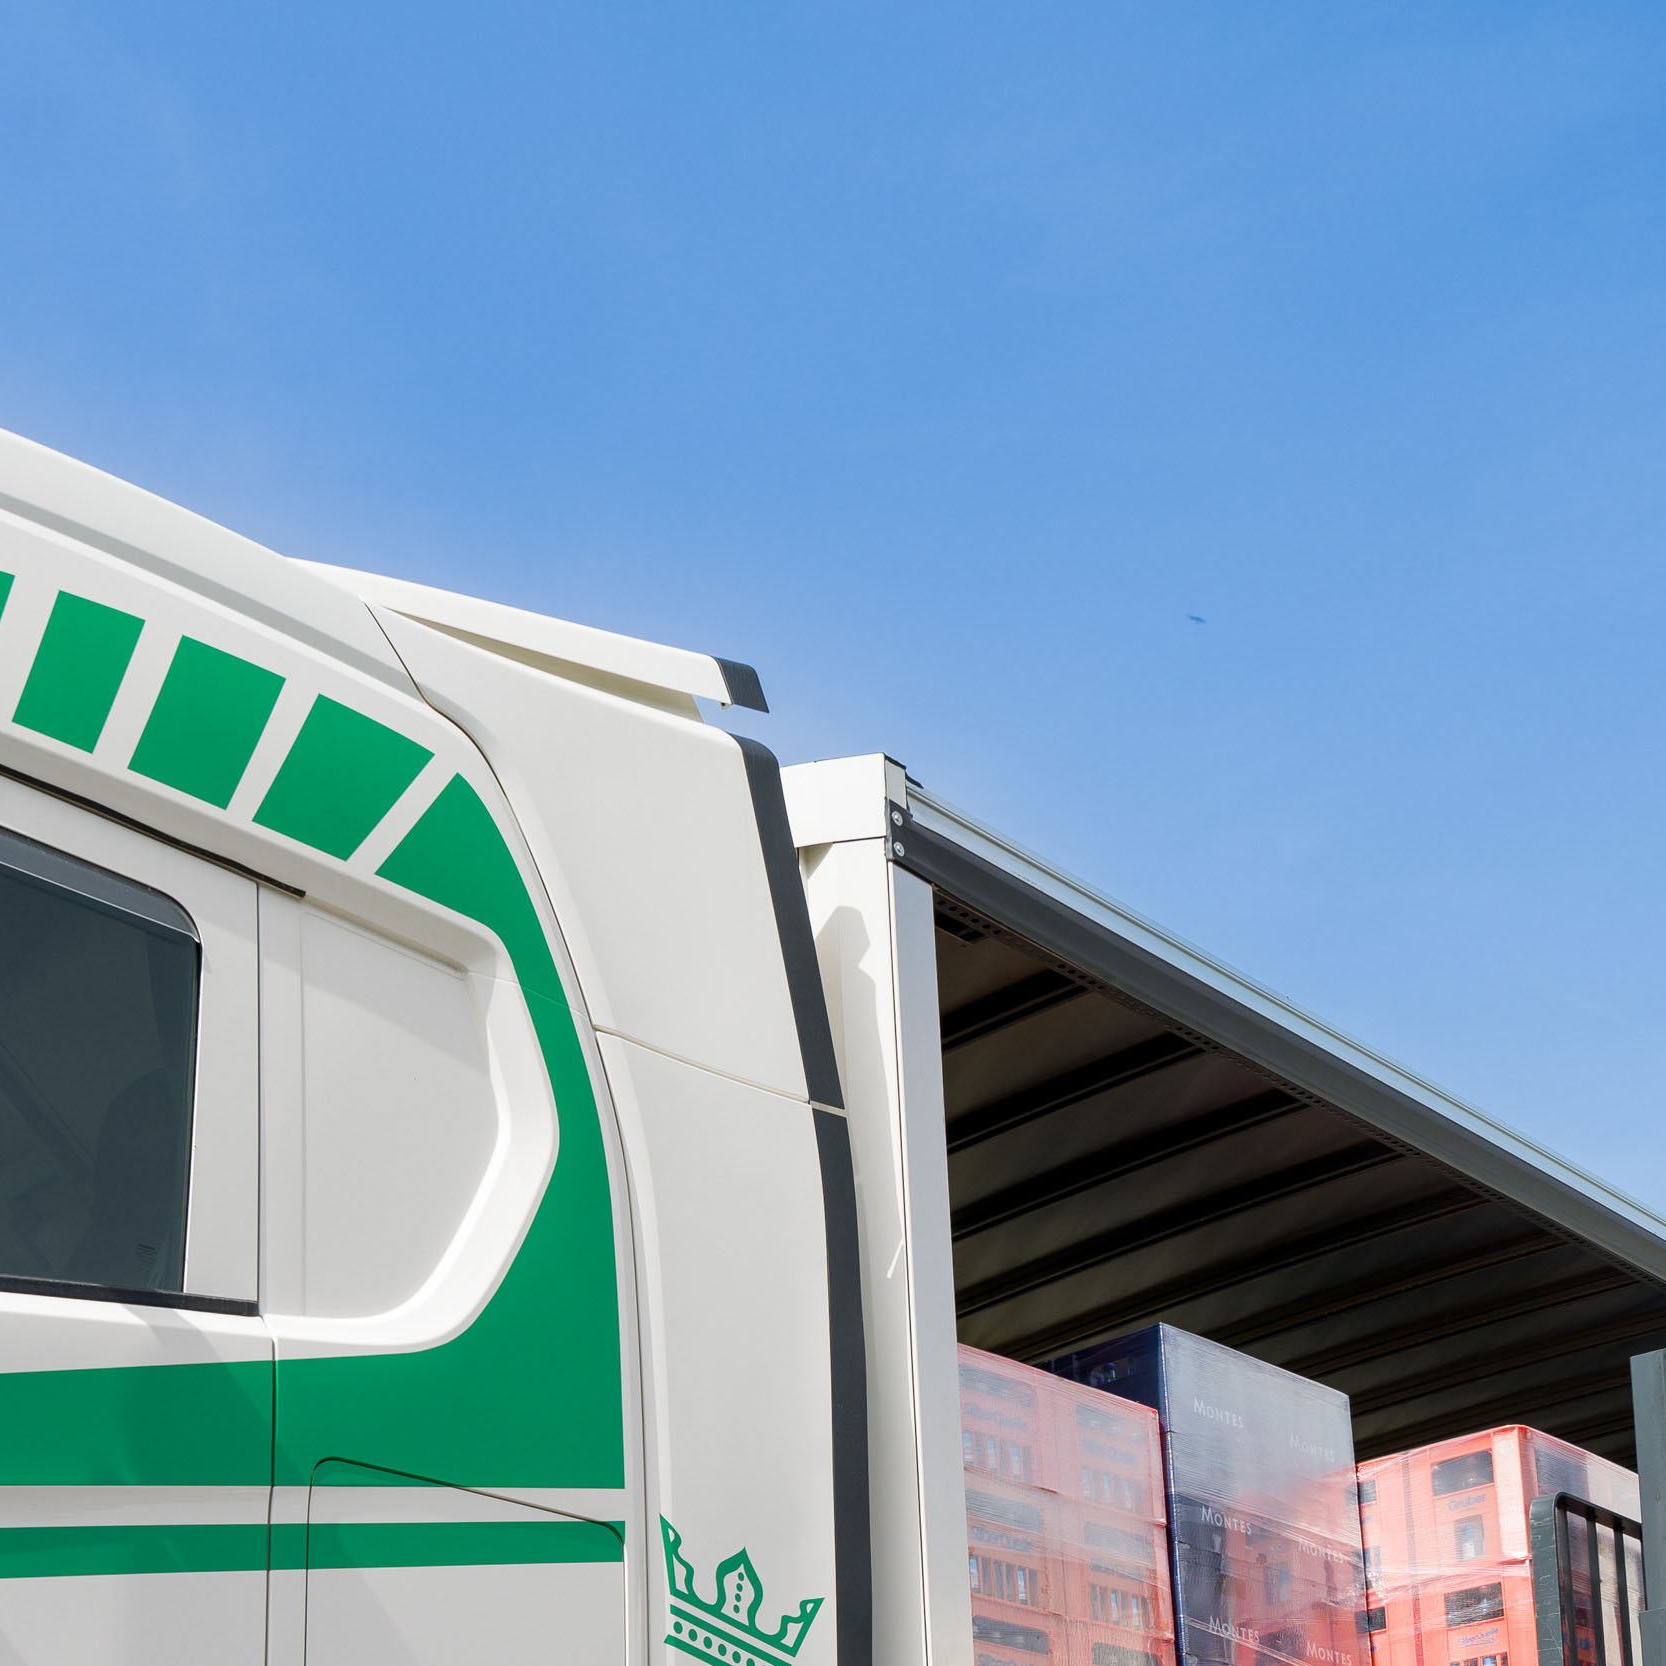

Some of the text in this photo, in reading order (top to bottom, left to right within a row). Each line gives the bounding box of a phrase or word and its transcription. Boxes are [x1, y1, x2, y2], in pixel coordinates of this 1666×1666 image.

[1201, 1505, 1253, 1536] MONTES
[1208, 1615, 1261, 1643] MONTES
[1306, 1641, 1353, 1666] MONTES
